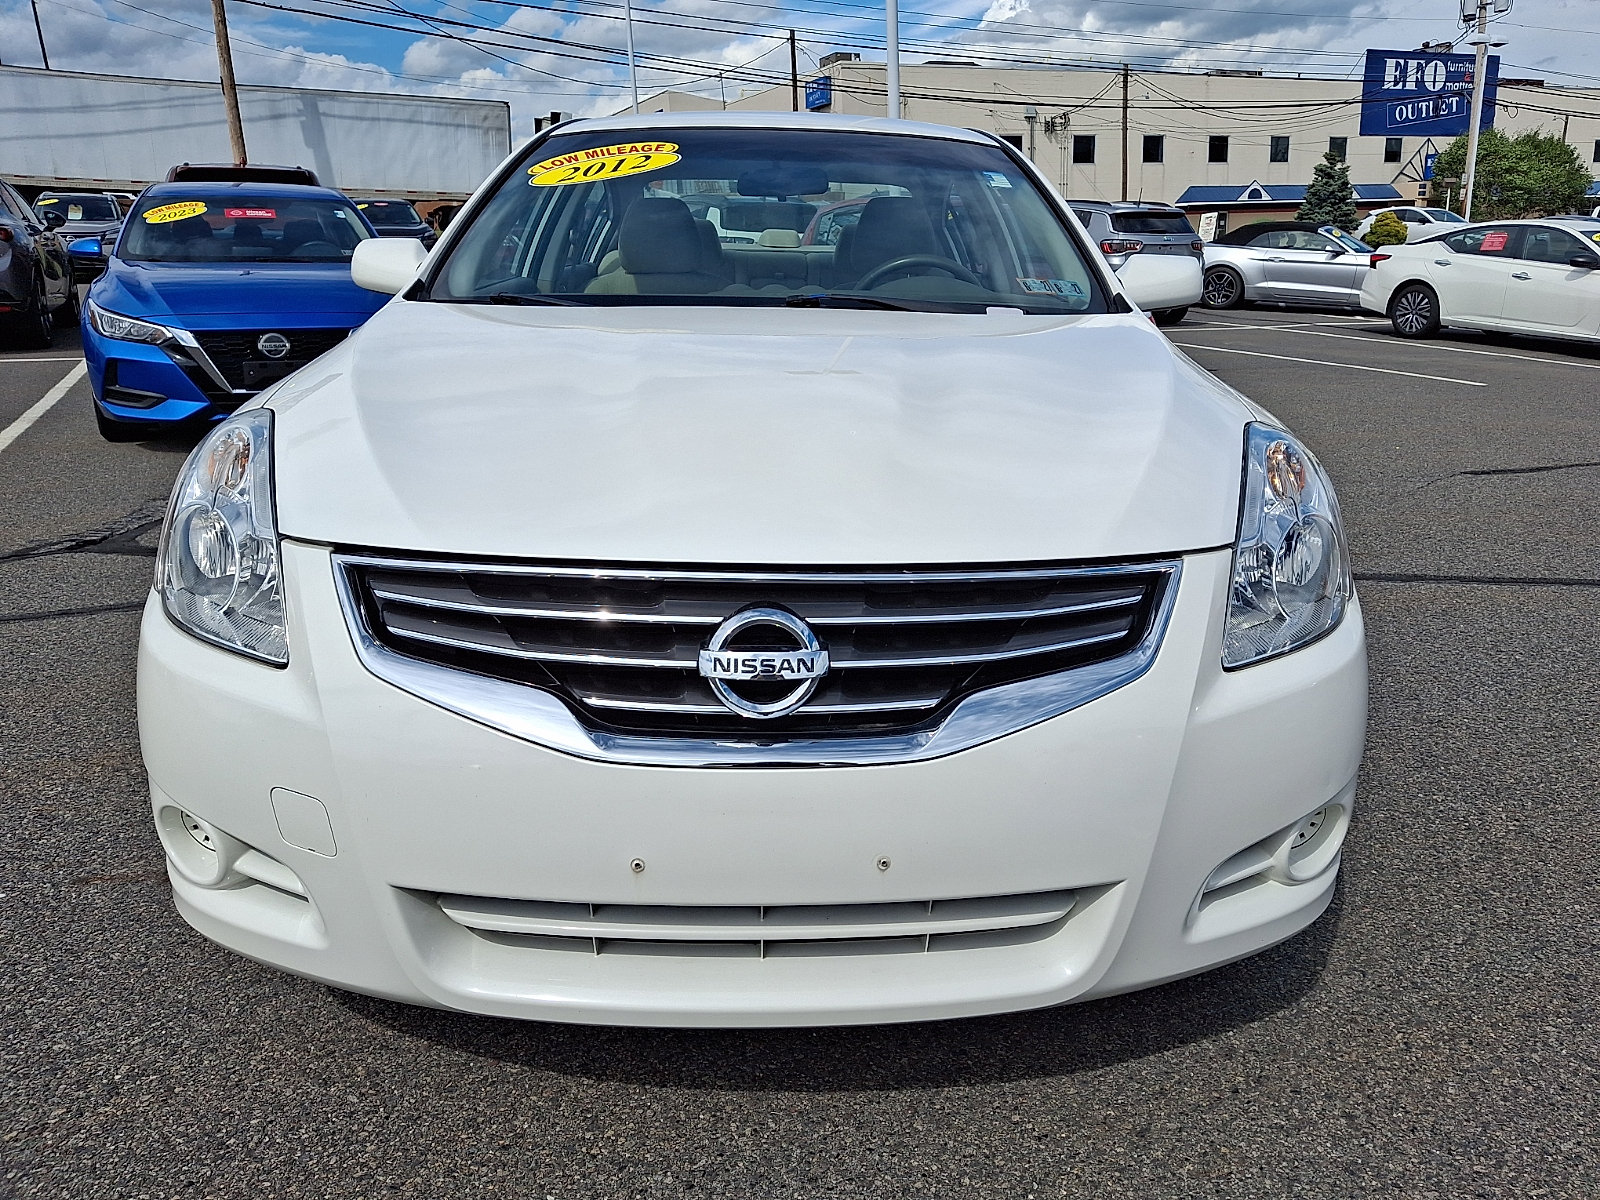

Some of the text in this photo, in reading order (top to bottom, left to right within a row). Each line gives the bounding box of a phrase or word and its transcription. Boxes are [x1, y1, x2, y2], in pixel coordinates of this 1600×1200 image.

[1382, 58, 1446, 91] EFO
[1447, 61, 1474, 72] furnitu
[1445, 82, 1473, 90] mattre
[1395, 97, 1459, 121] OUTLET
[539, 143, 666, 171] LOW MILEAGE
[556, 154, 652, 183] 2012
[158, 207, 196, 221] 2023
[165, 202, 199, 210] MILEAGE
[713, 657, 815, 674] NISSAN
